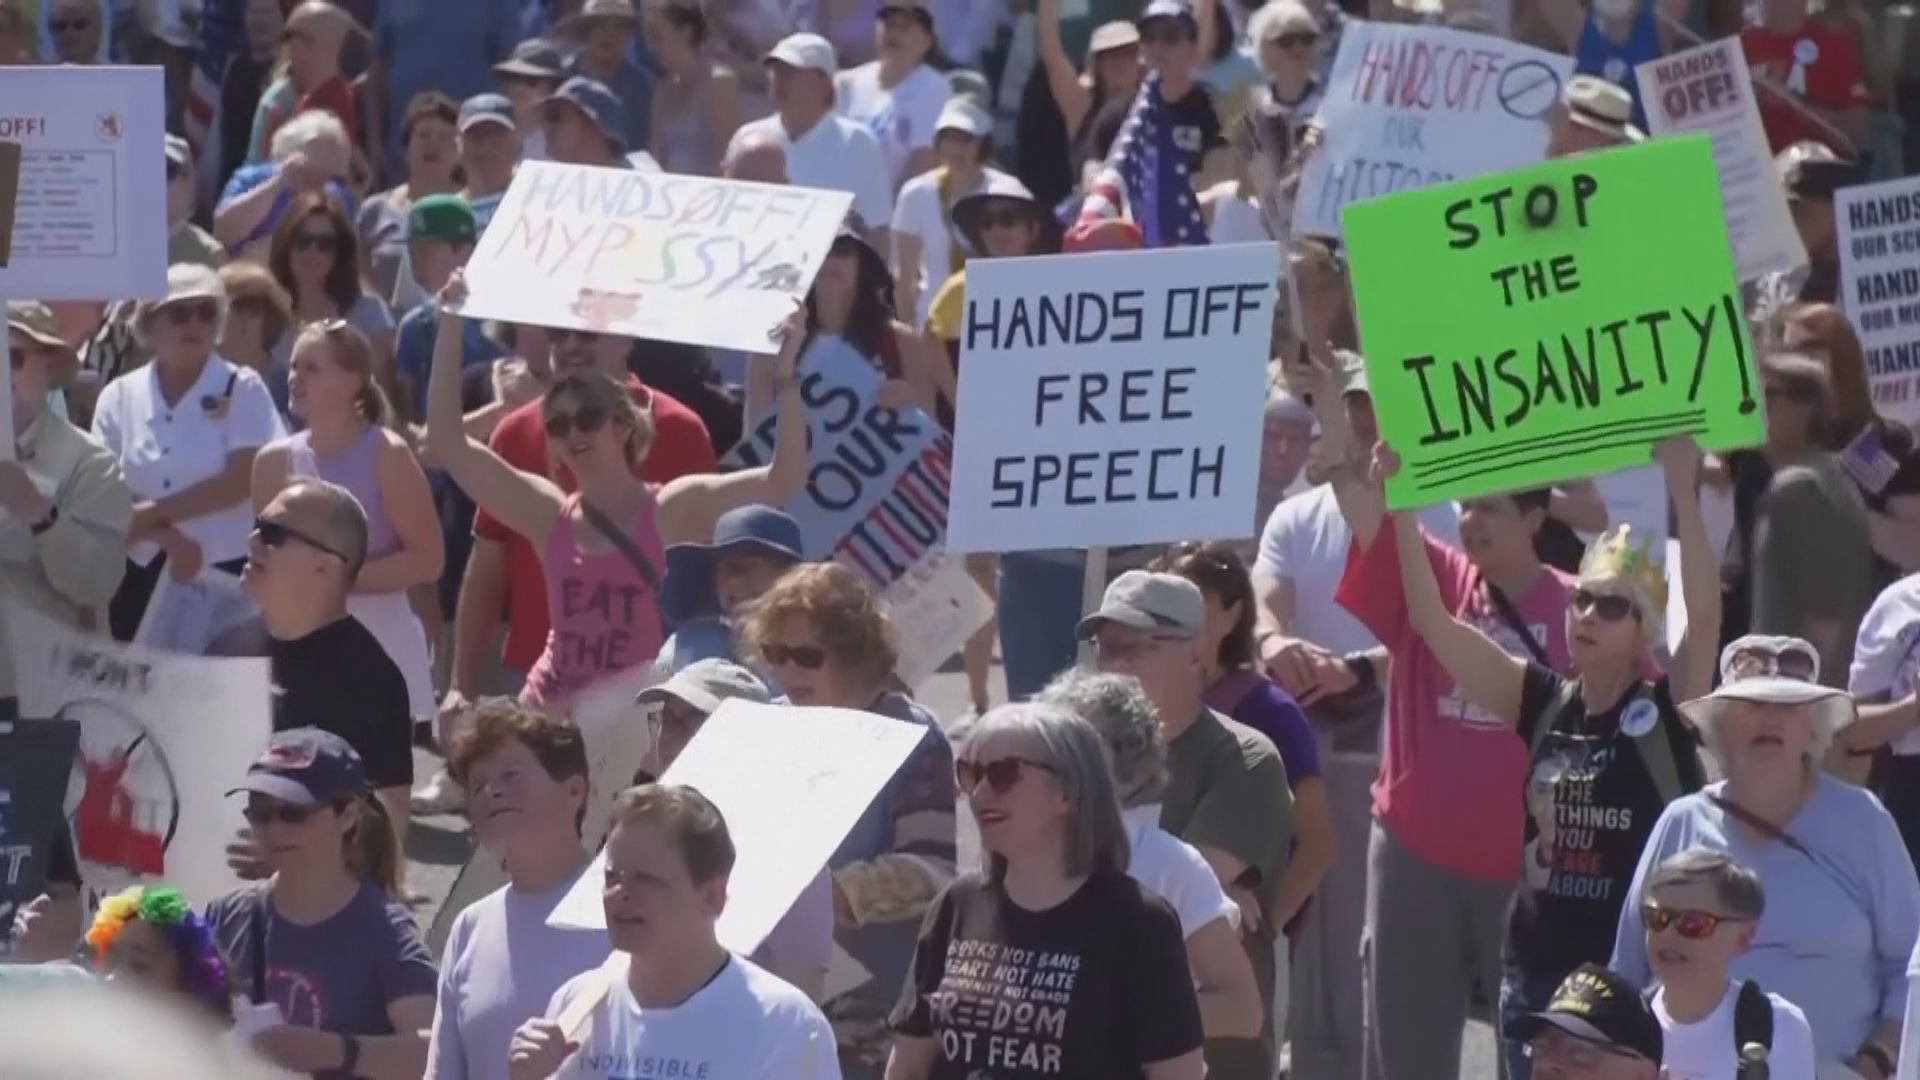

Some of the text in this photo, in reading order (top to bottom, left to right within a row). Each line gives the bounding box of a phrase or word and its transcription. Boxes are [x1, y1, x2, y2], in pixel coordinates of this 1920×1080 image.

[1352, 40, 1504, 112] HANDS OFF
[1655, 47, 1728, 84] HANDS
[1662, 72, 1739, 119] OFF!
[521, 170, 819, 241] HANDS OFF!
[1444, 173, 1598, 249] STOP
[492, 211, 594, 278] MY
[1852, 234, 1888, 260] OUR
[1490, 254, 1581, 307] THE
[967, 282, 1270, 350] HANDS OFF
[1861, 306, 1894, 331] OUR
[1402, 293, 1757, 446] INSANITY!
[1035, 367, 1197, 427] FREE
[805, 405, 921, 511] OUR
[991, 444, 1226, 509] SPEECH
[562, 579, 642, 625] EAT
[559, 629, 633, 671] THE
[1556, 804, 1632, 830] THINGS
[1556, 827, 1596, 850] YOU
[1549, 873, 1613, 900] ABOUT
[993, 964, 1030, 986] NOT
[1031, 970, 1077, 991] HATE
[1001, 946, 1036, 967] NOT
[1037, 950, 1081, 972] BANS
[926, 990, 1068, 1040] FREEDOM
[934, 1027, 1063, 1074] OT FEAR
